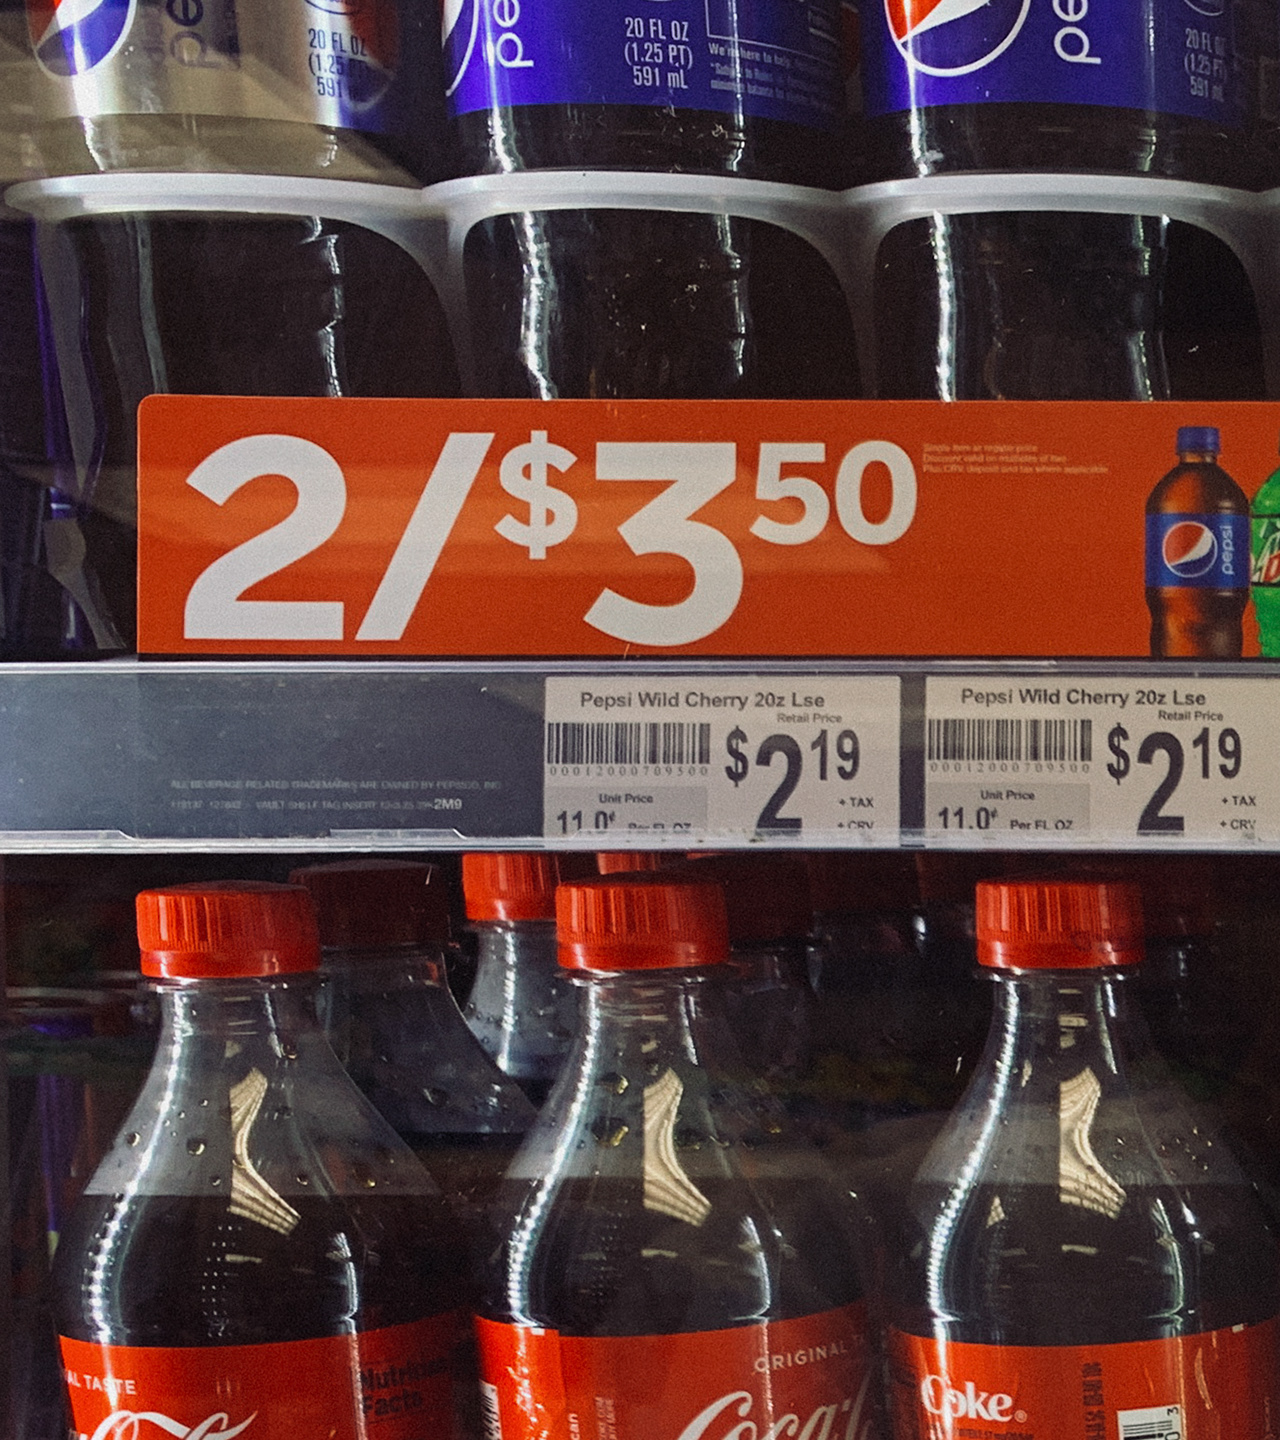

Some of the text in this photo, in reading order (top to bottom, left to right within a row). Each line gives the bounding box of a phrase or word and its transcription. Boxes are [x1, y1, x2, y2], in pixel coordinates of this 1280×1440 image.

[624, 18, 688, 41] 20 FL OZ
[624, 42, 661, 68] (1.25
[665, 44, 693, 69] PT)
[633, 65, 660, 87] 591
[667, 66, 688, 89] mL
[1222, 525, 1236, 575] pepsi
[580, 692, 632, 711] Pepsi
[637, 690, 680, 709] Wild
[685, 692, 750, 711] Cherry
[792, 692, 825, 710] Lse
[777, 713, 842, 724] Retail Price
